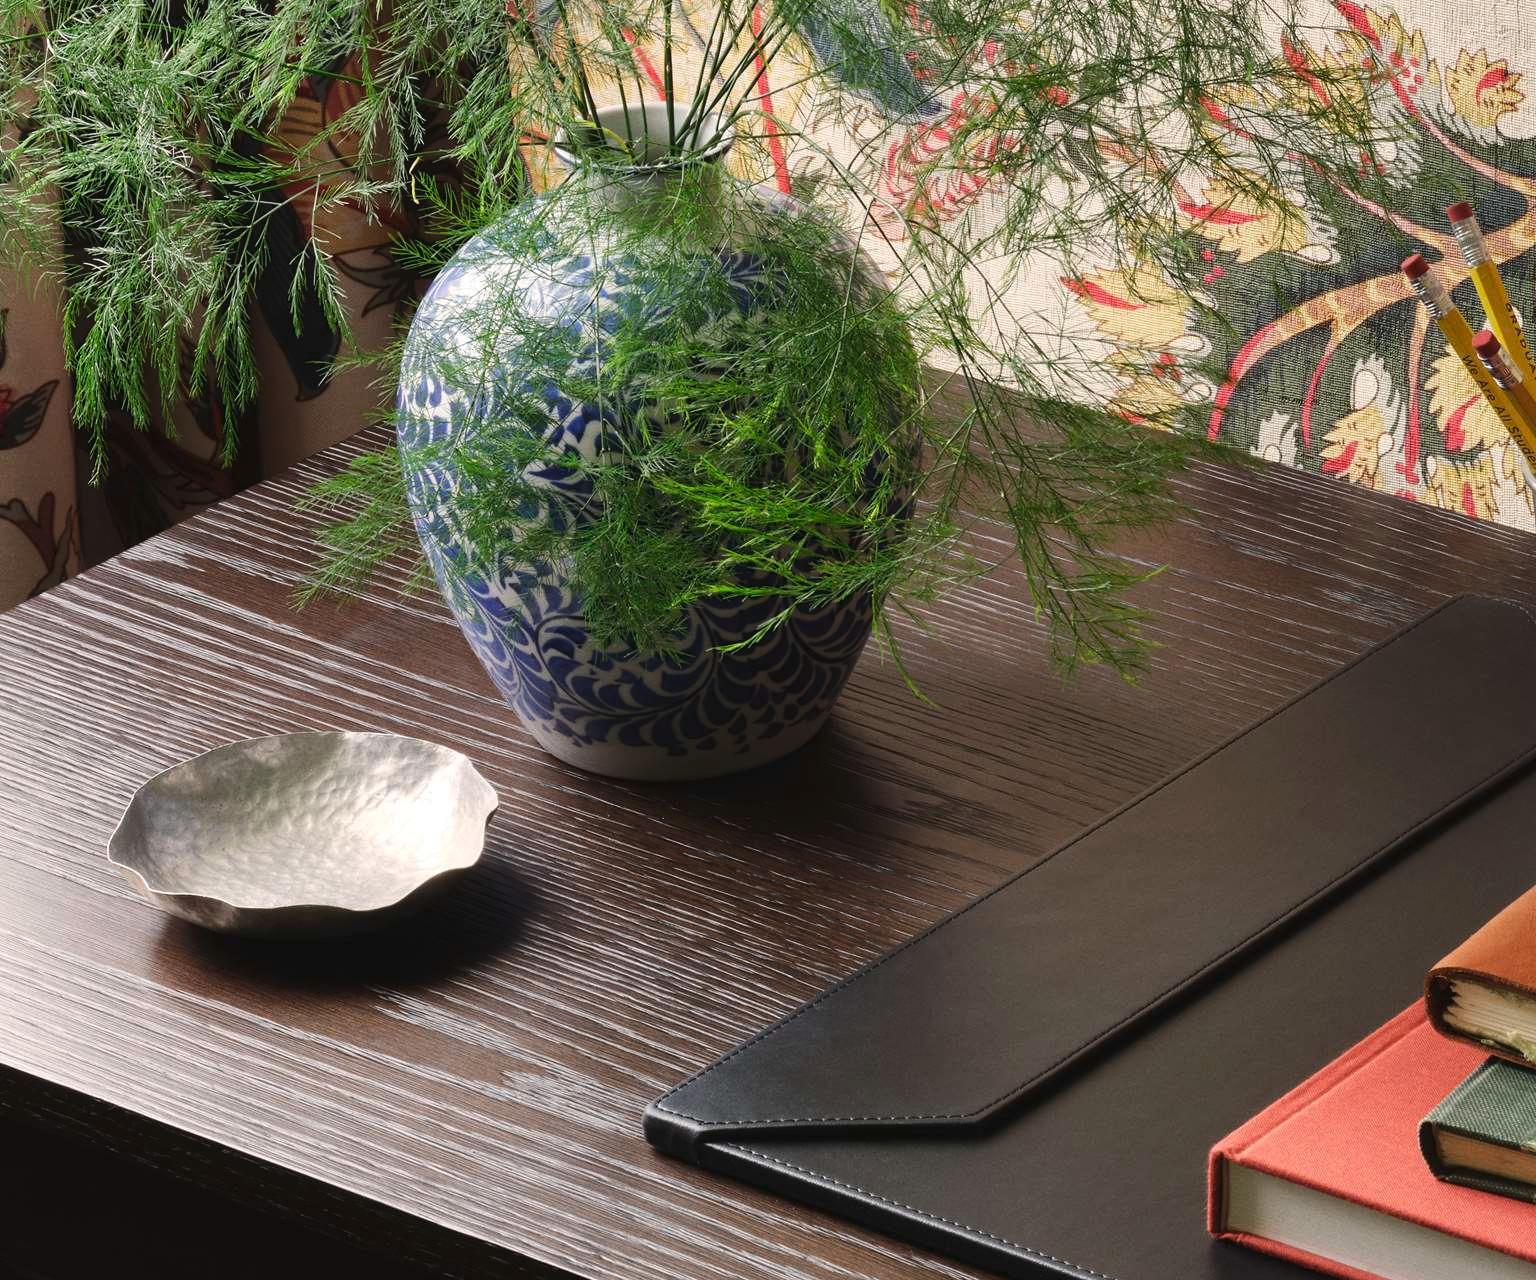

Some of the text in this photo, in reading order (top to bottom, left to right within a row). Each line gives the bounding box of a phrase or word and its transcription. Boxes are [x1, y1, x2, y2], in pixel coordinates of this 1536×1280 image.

[1462, 354, 1478, 375] We
[1478, 381, 1496, 402] Are
[1496, 405, 1513, 424] All
